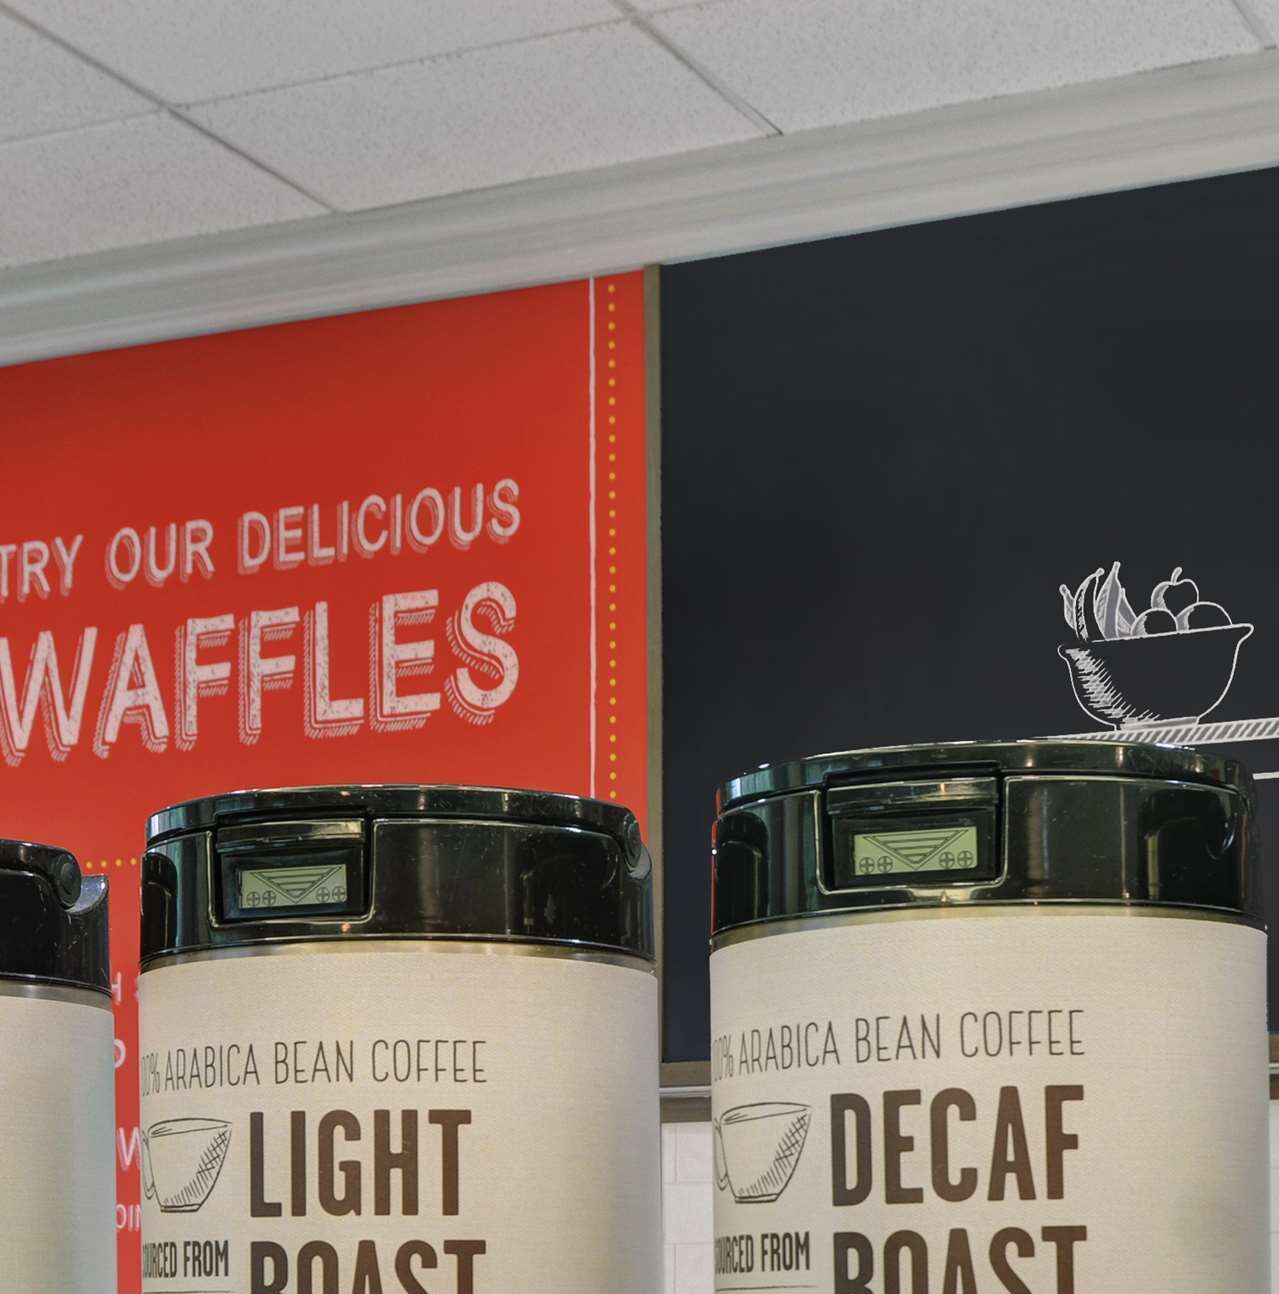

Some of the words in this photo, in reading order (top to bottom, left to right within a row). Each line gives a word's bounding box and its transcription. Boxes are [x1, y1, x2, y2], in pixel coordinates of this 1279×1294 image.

[106, 519, 214, 589] OUR
[237, 478, 521, 575] DELICIOUS
[164, 1043, 260, 1091] ARABICA
[275, 1040, 354, 1085] BEAN
[372, 1039, 487, 1083] COFFEE
[739, 1020, 840, 1075] ARABICA
[855, 1014, 941, 1064] BEAN
[960, 1009, 1085, 1058] COFFEE
[249, 1109, 472, 1218] LIGHT
[829, 1084, 1084, 1206] DECAF
[143, 1242, 177, 1278] OURCED
[183, 1240, 229, 1277] FROM
[716, 1234, 754, 1274] OURCED
[761, 1231, 810, 1272] FROM
